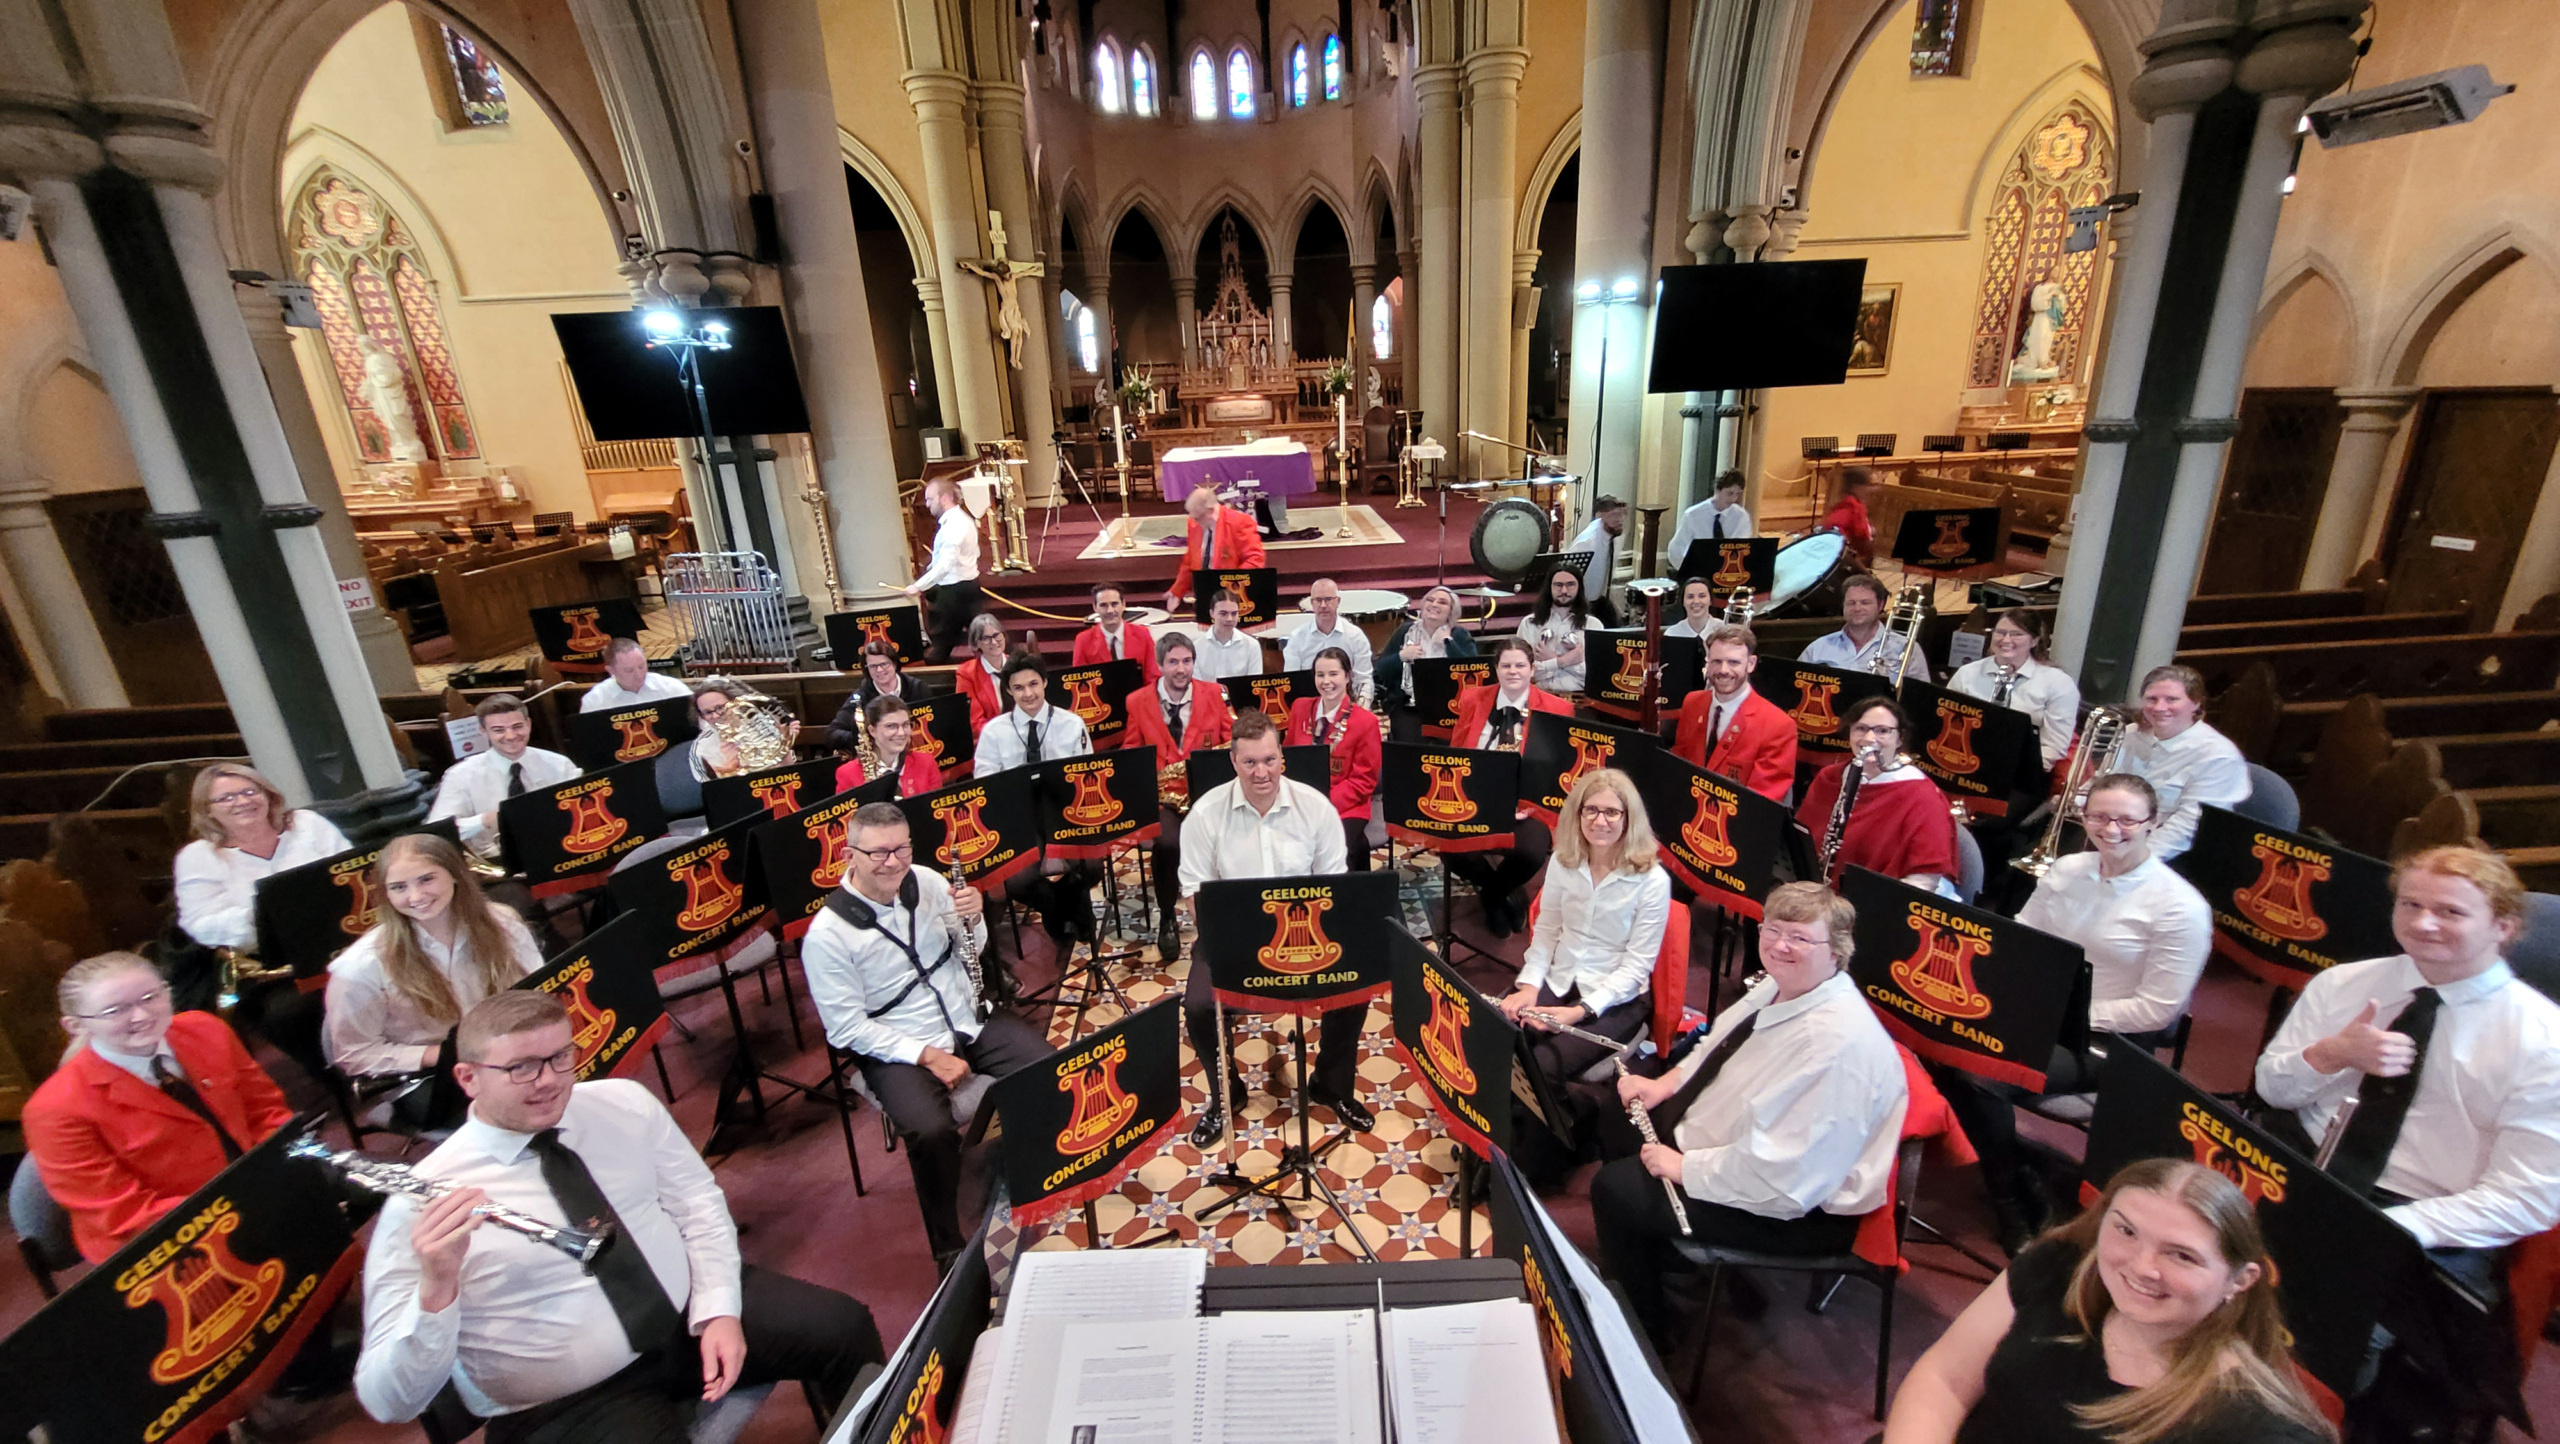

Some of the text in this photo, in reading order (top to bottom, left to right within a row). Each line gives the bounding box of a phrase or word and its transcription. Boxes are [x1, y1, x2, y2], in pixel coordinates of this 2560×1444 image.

[339, 581, 361, 592] NO
[1220, 573, 1250, 581] GEELONG
[560, 606, 598, 617] GEELONG
[856, 614, 890, 624] GEELONG
[562, 652, 598, 661] CONCERT
[1061, 670, 1102, 682] GEELONG
[1449, 663, 1490, 673] GEELONG
[1795, 671, 1841, 685] GEELONG
[1251, 678, 1291, 688] GEELONG
[1601, 691, 1640, 701] CONCERT
[610, 708, 658, 722] GEELONG
[1937, 697, 1983, 719] GEELONG
[1099, 720, 1122, 732] BAND
[1568, 727, 1615, 746] GEELONG
[1063, 759, 1113, 773] GEELONG
[1421, 754, 1471, 766] GEELONG
[555, 777, 611, 800] GEELONG
[750, 772, 801, 789] GEELONG
[1691, 775, 1739, 805] GEELONG
[1957, 776, 1988, 794] BAND
[930, 786, 985, 810] GEELONG
[803, 797, 858, 828] GEELONG
[1054, 820, 1136, 840] CONCERT BAND
[1404, 819, 1490, 833] CONCERT BAND
[554, 835, 645, 873] CONCERT BAND
[667, 838, 727, 871] GEELONG
[984, 849, 1015, 867] BAND
[2254, 832, 2333, 868] GEELONG
[1669, 842, 1746, 891] CONCERT BAND
[1261, 886, 1332, 901] GEELONG
[667, 904, 765, 958] CONCERT BAND
[1909, 901, 1993, 942] GEELONG
[1243, 970, 1359, 989] CONCERT BAND
[1421, 962, 1470, 1013] GEELONG
[1866, 983, 2004, 1053] CONCERT BAND
[600, 1026, 637, 1062] BAND
[1056, 1033, 1126, 1077] GEELONG
[1412, 1047, 1491, 1132] CONCERT BAND
[2182, 1102, 2288, 1184] GEELONG
[1043, 1119, 1154, 1191] CONCERT BAND
[115, 1195, 233, 1292] GEELONG
[1523, 1244, 1572, 1360] GEELONG
[143, 1273, 318, 1444] CONCERT BAND
